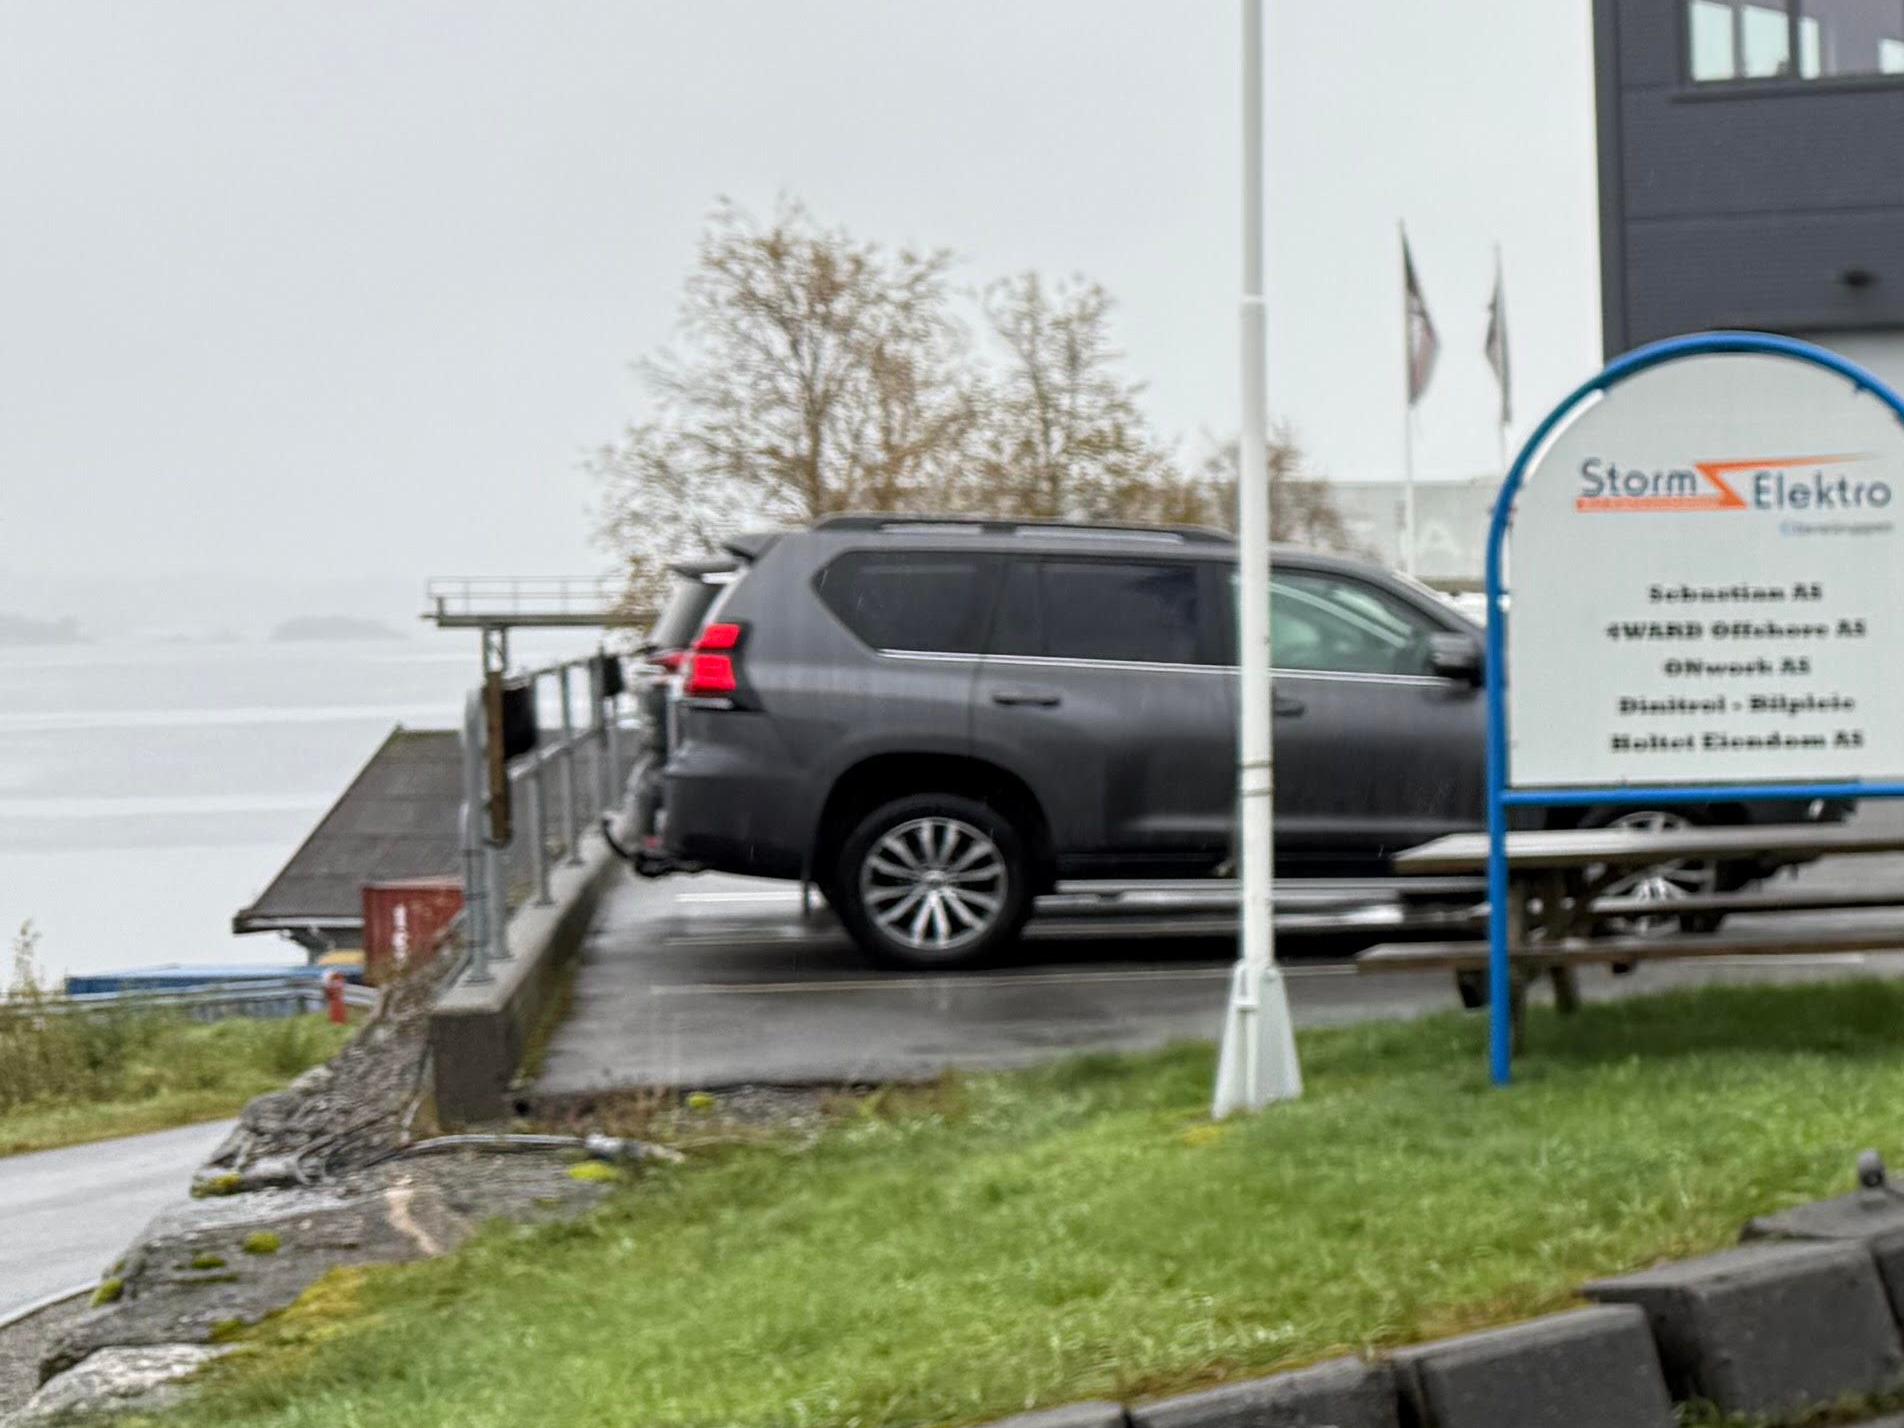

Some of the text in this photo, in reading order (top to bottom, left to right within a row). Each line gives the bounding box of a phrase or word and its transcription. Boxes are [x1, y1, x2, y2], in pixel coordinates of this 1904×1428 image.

[1579, 456, 1893, 511] Storm Elektro
[1649, 582, 1823, 603] Sebastian AS
[1607, 618, 1867, 641] 4WARD Offshore AS
[1780, 655, 1811, 676] AS
[1702, 731, 1827, 752] Eiendom
[1834, 728, 1864, 750] AS
